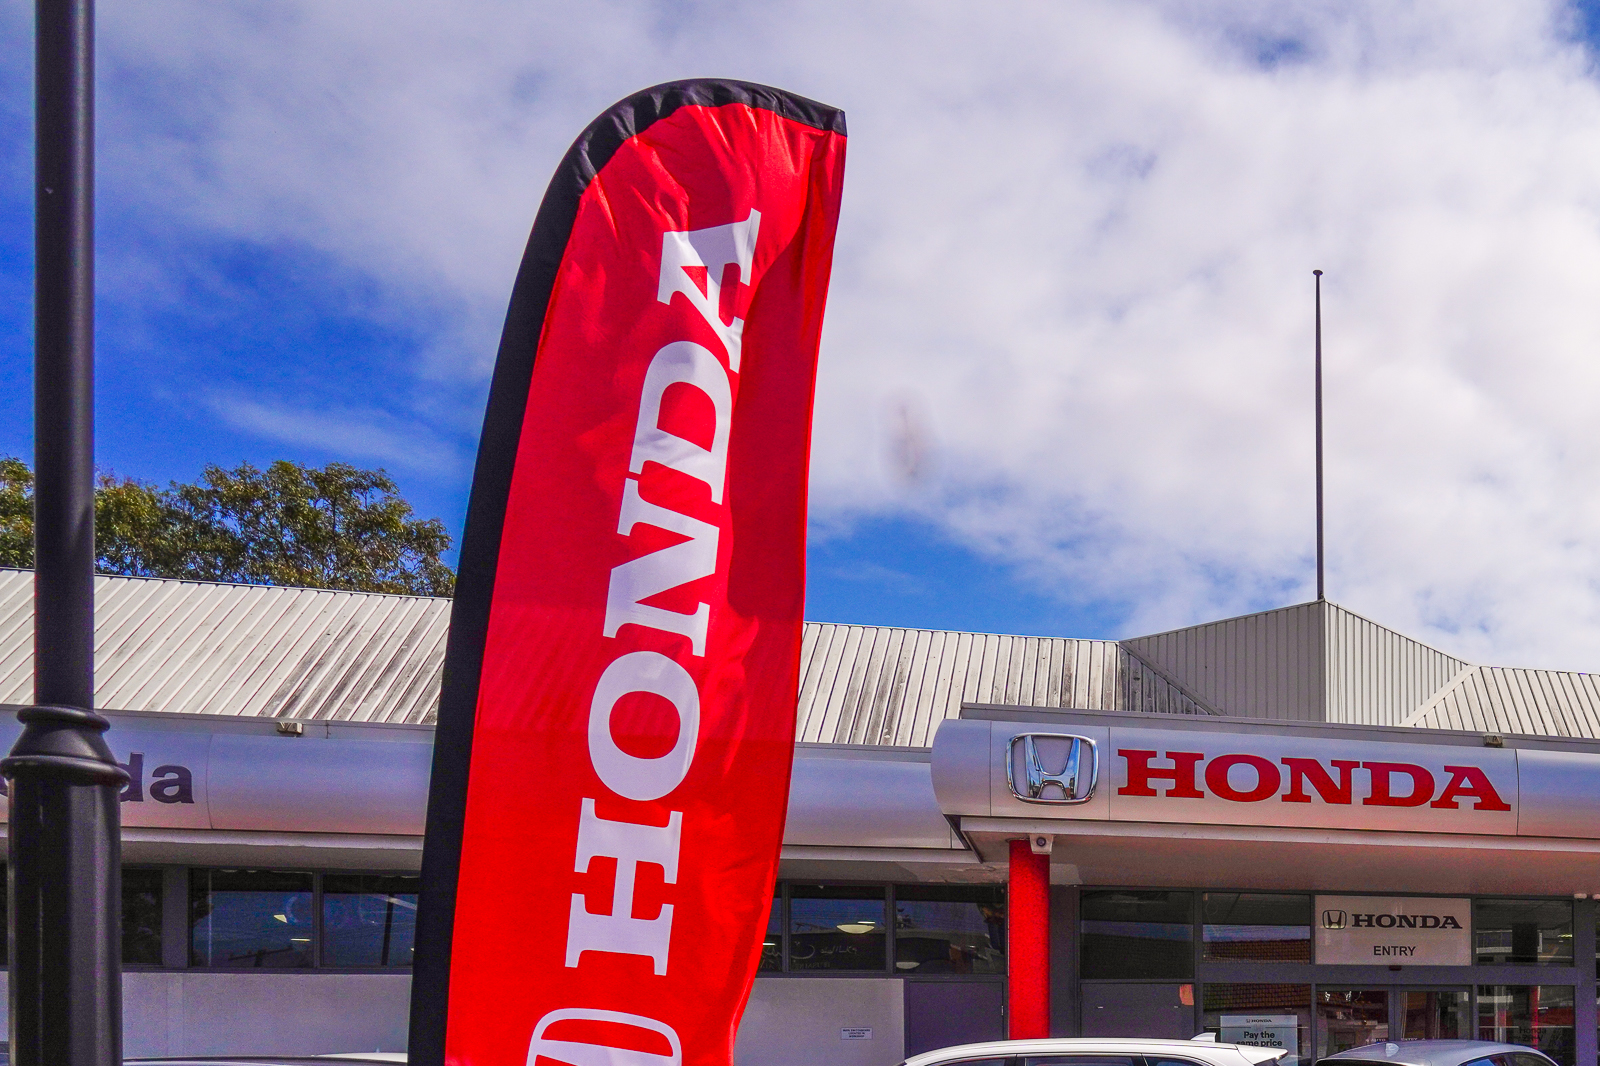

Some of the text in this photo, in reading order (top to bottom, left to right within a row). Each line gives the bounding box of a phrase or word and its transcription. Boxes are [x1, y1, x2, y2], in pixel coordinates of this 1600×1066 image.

[564, 207, 762, 976] HONDA
[1116, 748, 1512, 812] HONDA
[1351, 913, 1463, 930] HONDA
[1373, 945, 1416, 957] ENTRY
[1243, 1031, 1275, 1040] Pay the
[1260, 1039, 1283, 1048] price
